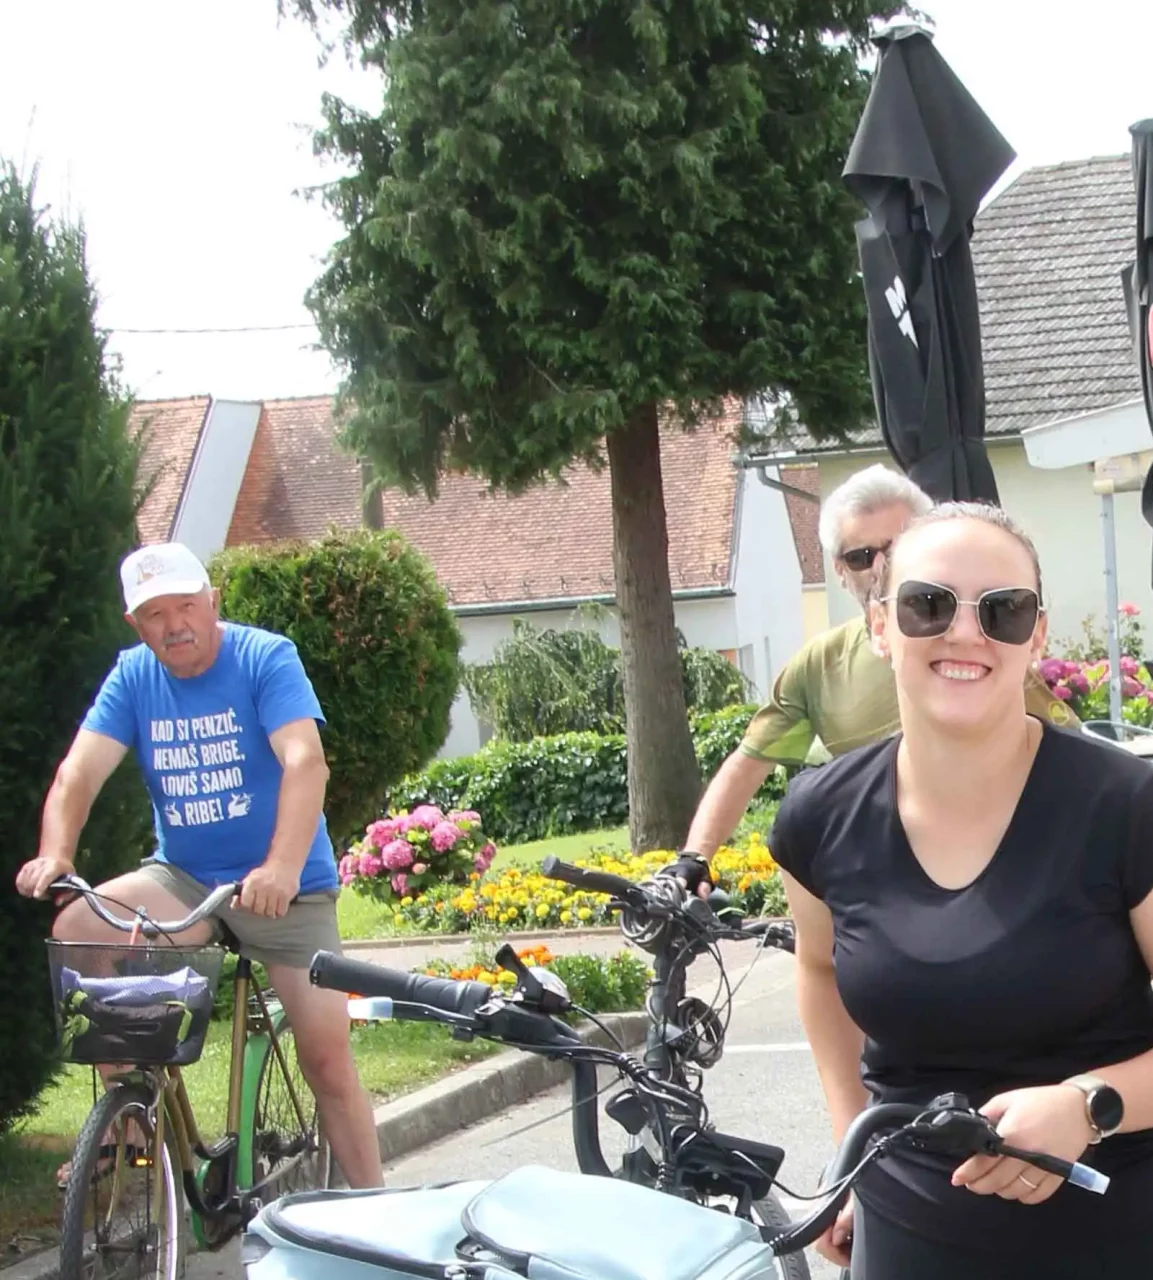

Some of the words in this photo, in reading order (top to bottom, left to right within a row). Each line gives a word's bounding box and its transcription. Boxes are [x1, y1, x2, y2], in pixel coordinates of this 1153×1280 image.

[151, 720, 174, 742] KAD
[176, 719, 189, 741] SI
[154, 743, 199, 771] NEMAŠ
[200, 740, 246, 766] BRIGE,
[162, 770, 198, 797] LOVIŠ
[201, 767, 243, 794] SAMO
[184, 798, 224, 826] RIBE!
